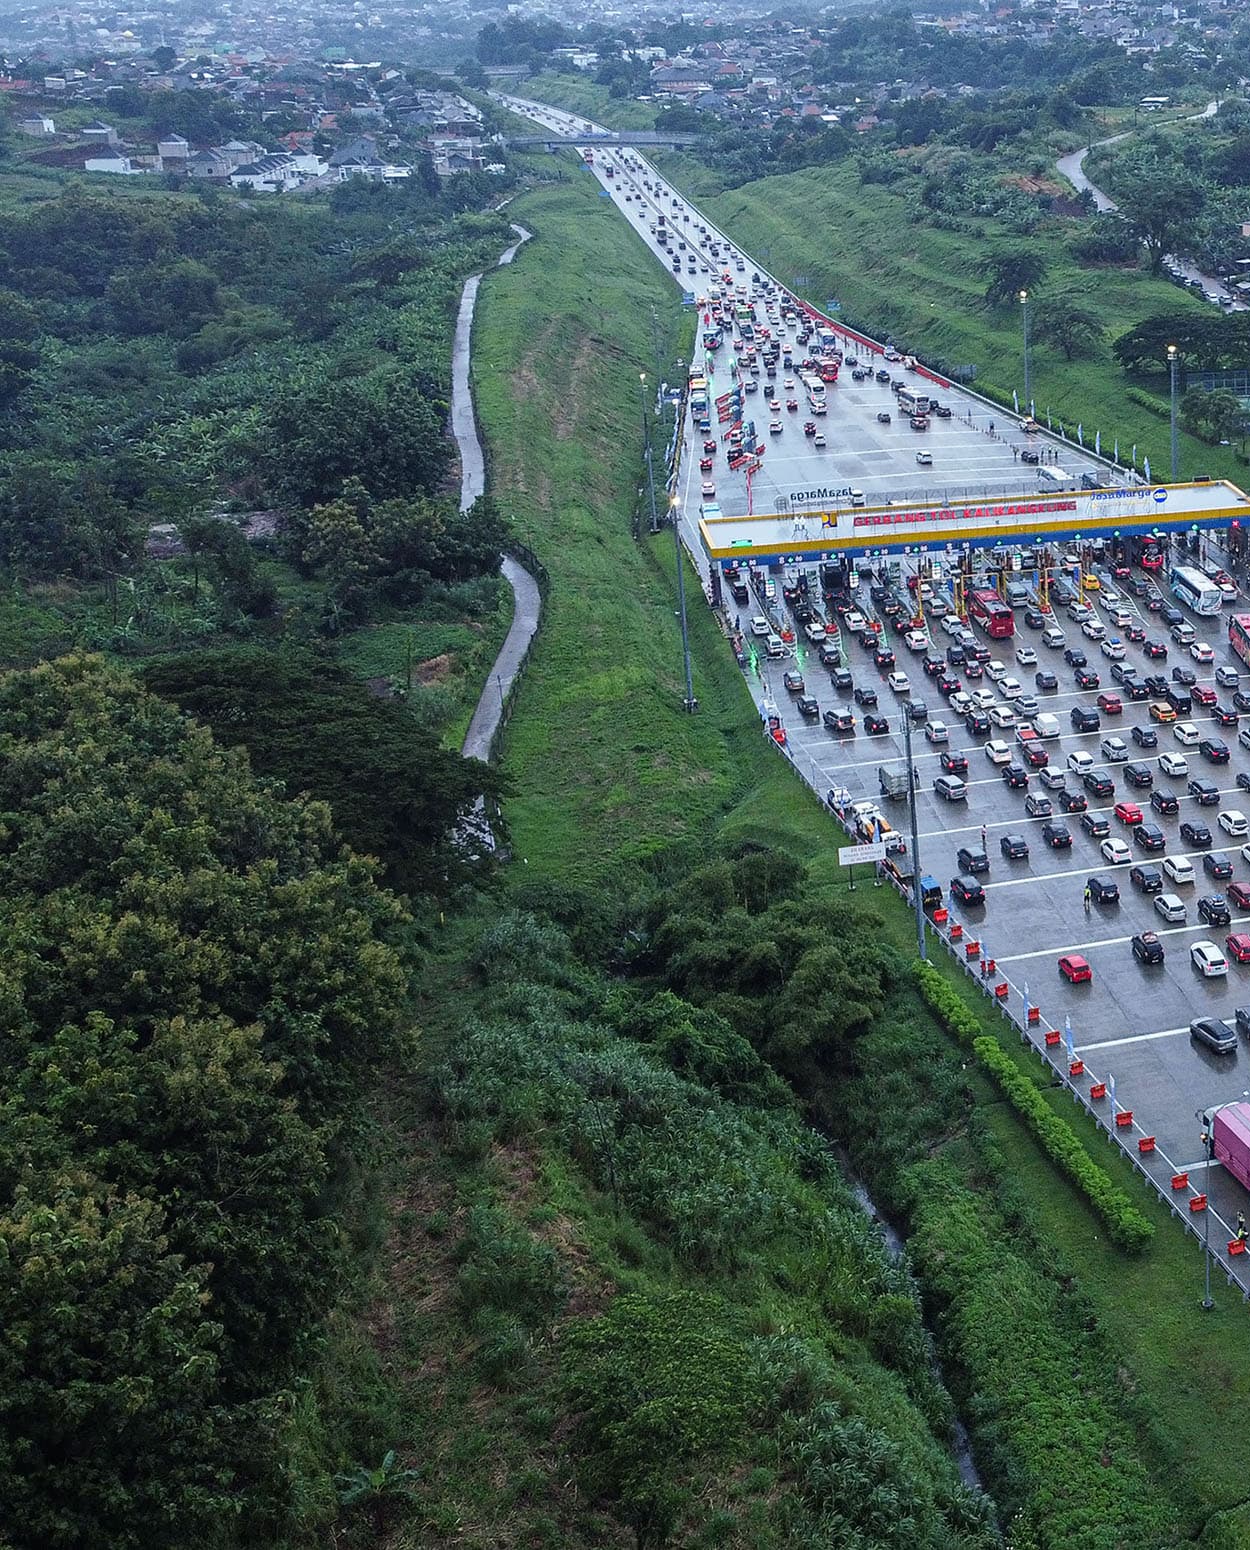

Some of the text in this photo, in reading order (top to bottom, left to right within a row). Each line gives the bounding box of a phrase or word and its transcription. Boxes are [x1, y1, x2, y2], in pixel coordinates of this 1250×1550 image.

[1090, 489, 1151, 500] JasaMarga
[853, 500, 1077, 527] GERBANG TOL KALIKANGKUNG
